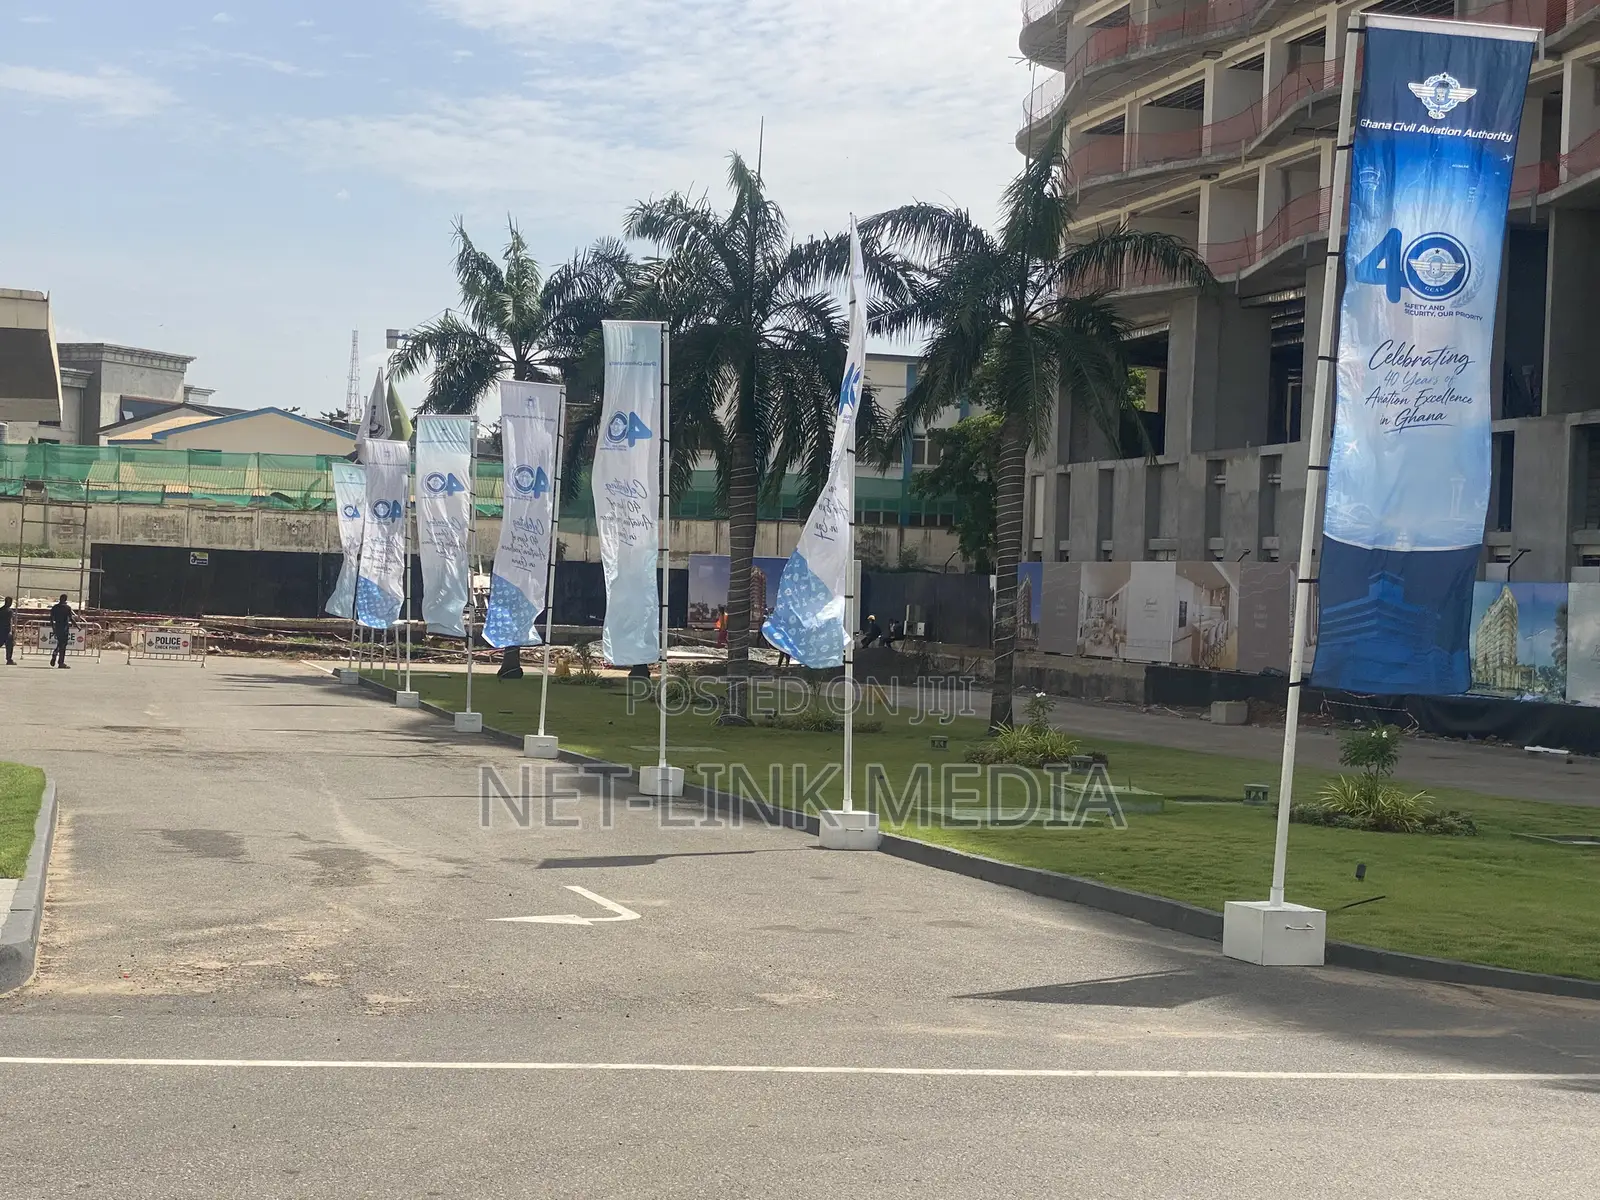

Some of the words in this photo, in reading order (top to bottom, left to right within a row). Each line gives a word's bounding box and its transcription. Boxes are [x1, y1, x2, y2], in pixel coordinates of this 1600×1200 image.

[1360, 118, 1392, 130] Ghana
[1393, 121, 1416, 133] Civil
[1417, 124, 1461, 137] Aviation
[1463, 128, 1513, 142] Authority
[1404, 302, 1427, 311] SAFETY
[1455, 310, 1483, 321] PRIORITY
[1368, 339, 1476, 376] Celebrating
[1384, 371, 1399, 387] 40
[1402, 372, 1439, 392] Years
[1444, 373, 1459, 390] of
[1364, 386, 1410, 409] Aviation
[1413, 387, 1473, 409] Excellence
[1379, 414, 1390, 426] in
[1394, 406, 1448, 431] Ghana
[155, 636, 181, 645] POLICE
